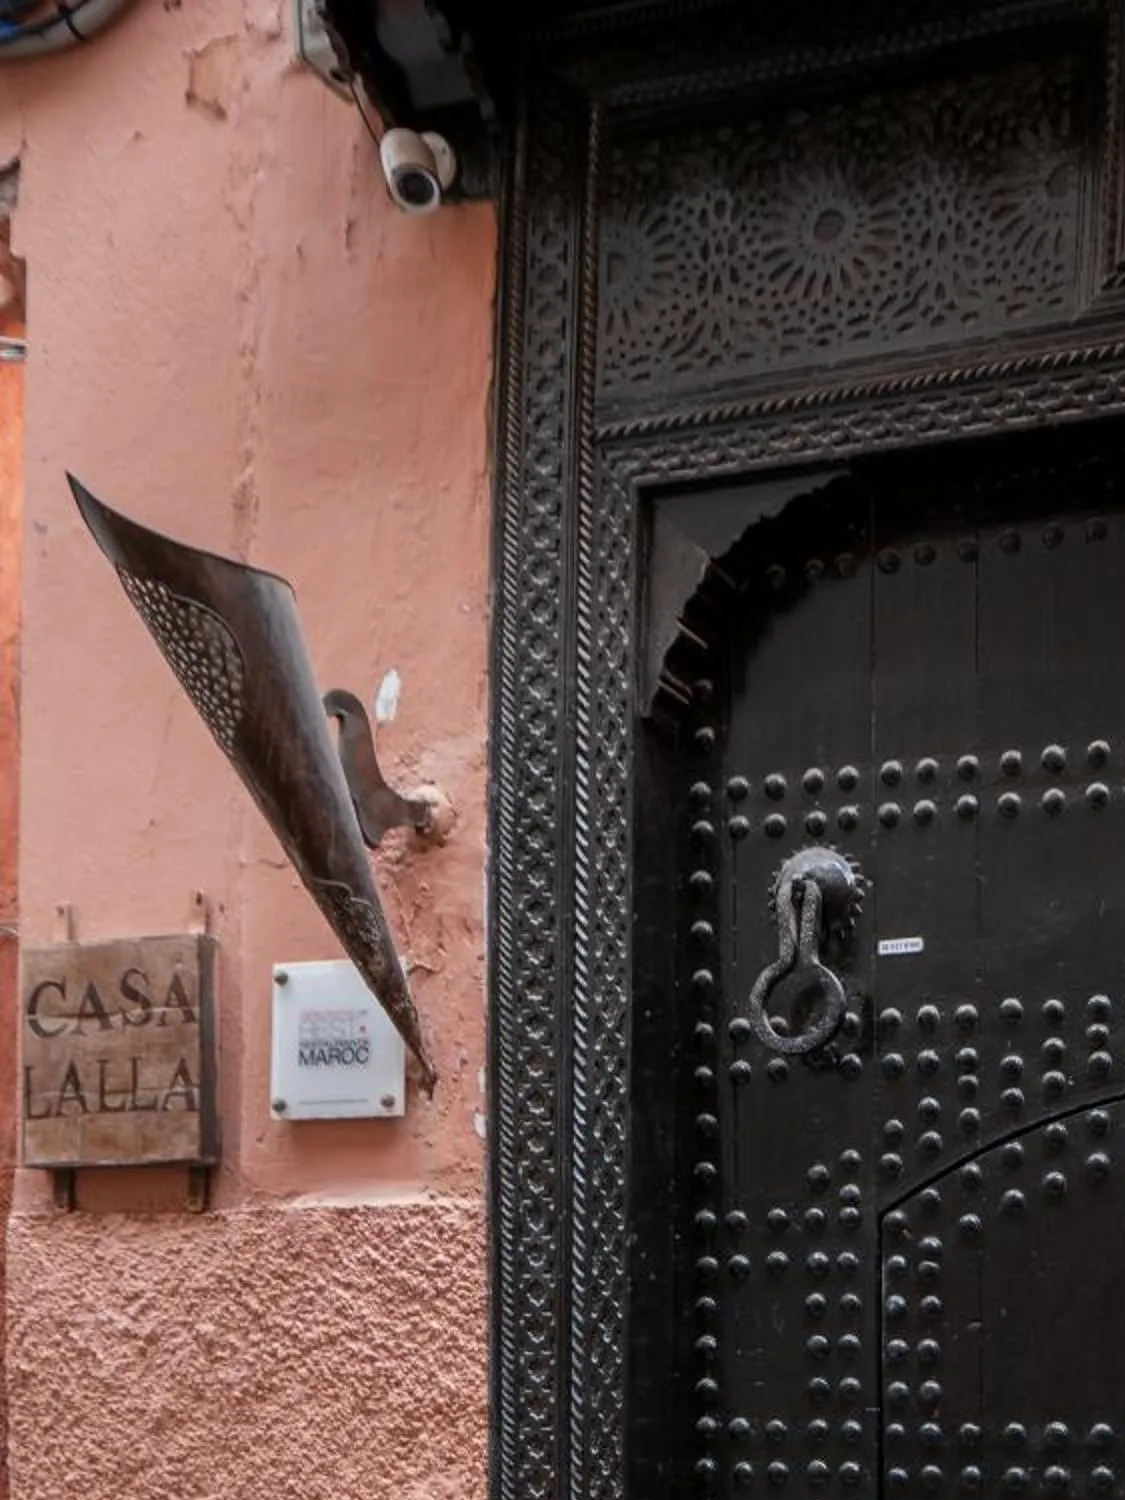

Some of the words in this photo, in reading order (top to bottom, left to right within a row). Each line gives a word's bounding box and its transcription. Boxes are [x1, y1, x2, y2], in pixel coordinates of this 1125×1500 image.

[28, 968, 197, 1038] CASA
[24, 1056, 198, 1119] LALLA
[298, 1047, 369, 1066] MAROC
